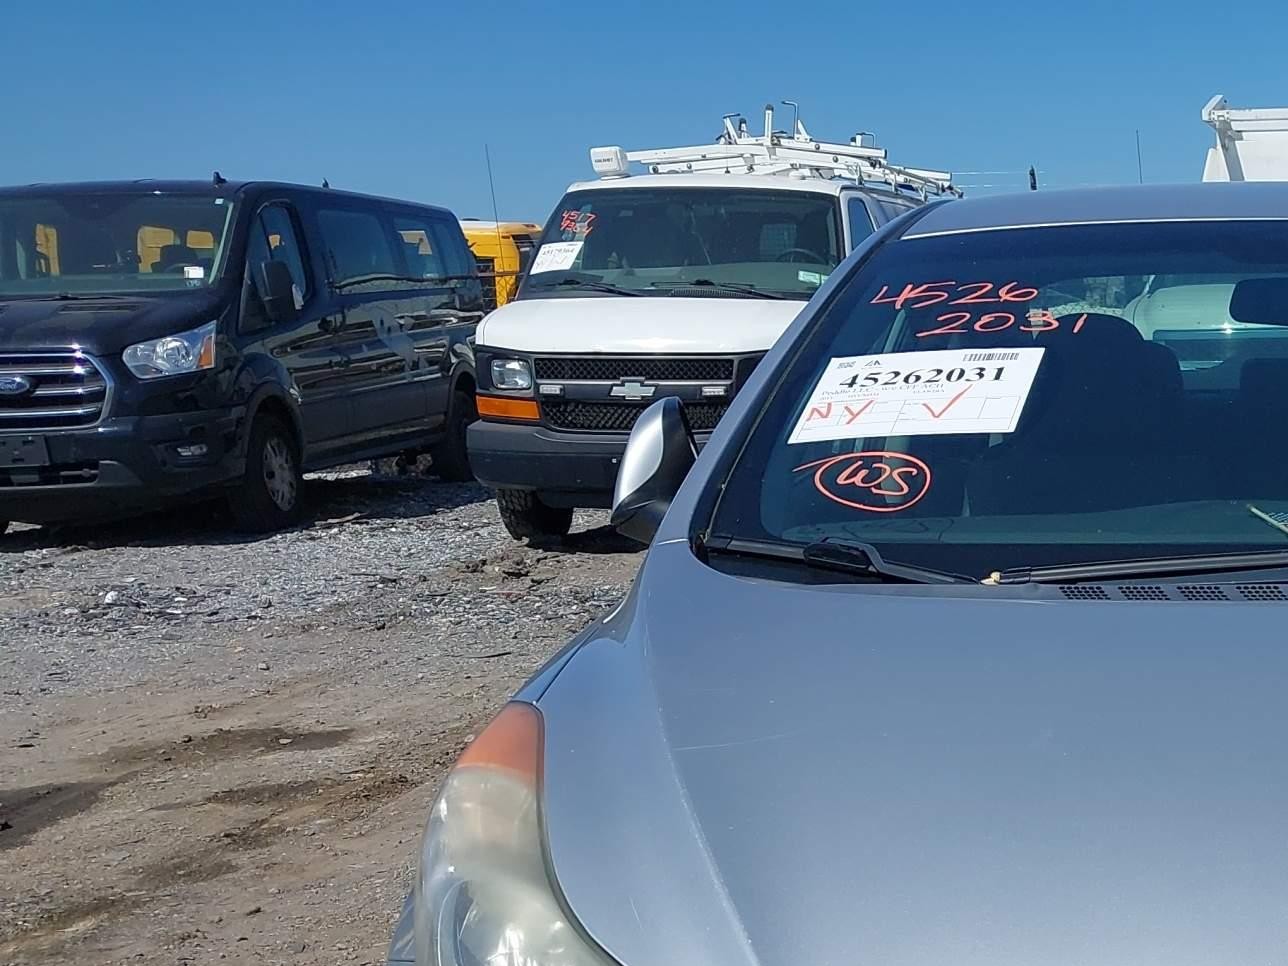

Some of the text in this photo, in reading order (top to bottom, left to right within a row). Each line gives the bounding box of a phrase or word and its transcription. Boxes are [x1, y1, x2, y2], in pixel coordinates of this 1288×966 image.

[869, 281, 1039, 310] 4526
[915, 312, 1088, 337] 2031
[839, 366, 1008, 388] 45262031
[836, 461, 918, 496] WS
